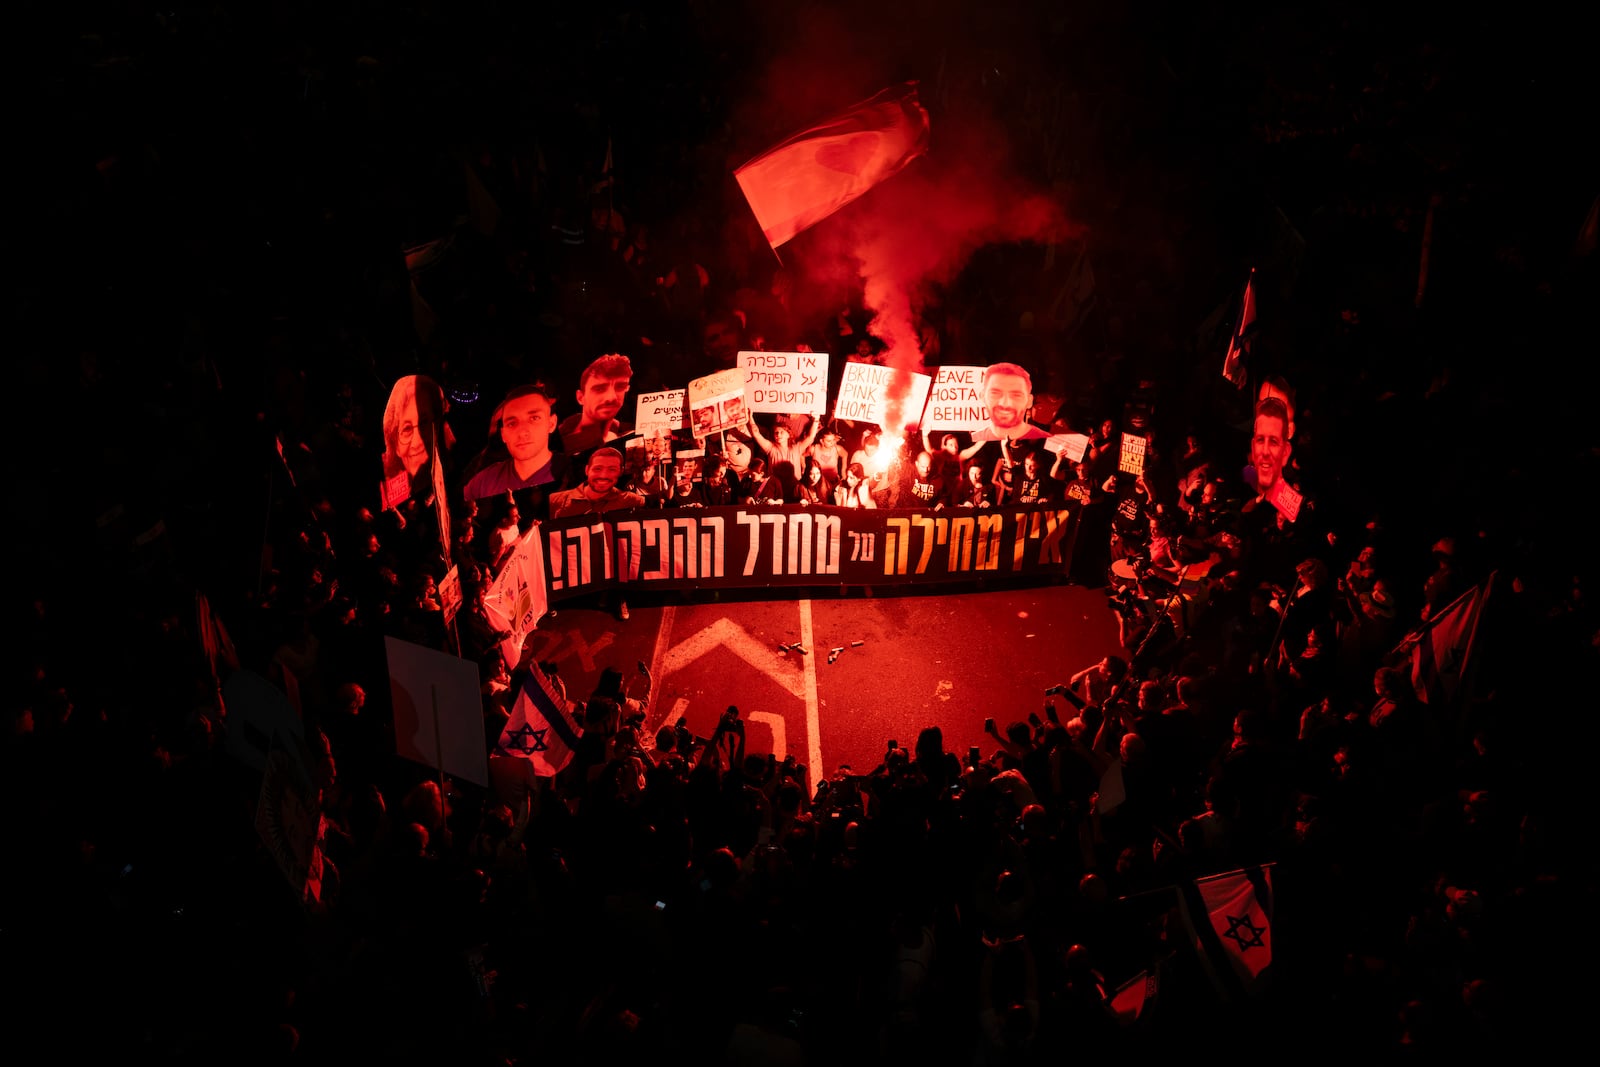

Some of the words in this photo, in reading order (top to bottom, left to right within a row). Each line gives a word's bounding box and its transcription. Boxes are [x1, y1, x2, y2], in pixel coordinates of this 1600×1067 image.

[747, 356, 787, 368] כפרה
[797, 357, 816, 370] אין
[745, 371, 792, 386] הפקרת
[800, 372, 818, 386] על
[848, 365, 892, 386] BRING
[753, 390, 814, 404] החטופים
[844, 383, 878, 403] PINK
[840, 400, 876, 420] HOME
[737, 511, 841, 576] מחדל
[848, 530, 875, 561] על
[884, 514, 1003, 575] מחילה
[1012, 510, 1069, 571] אין
[549, 516, 725, 591] ההפקרה!
